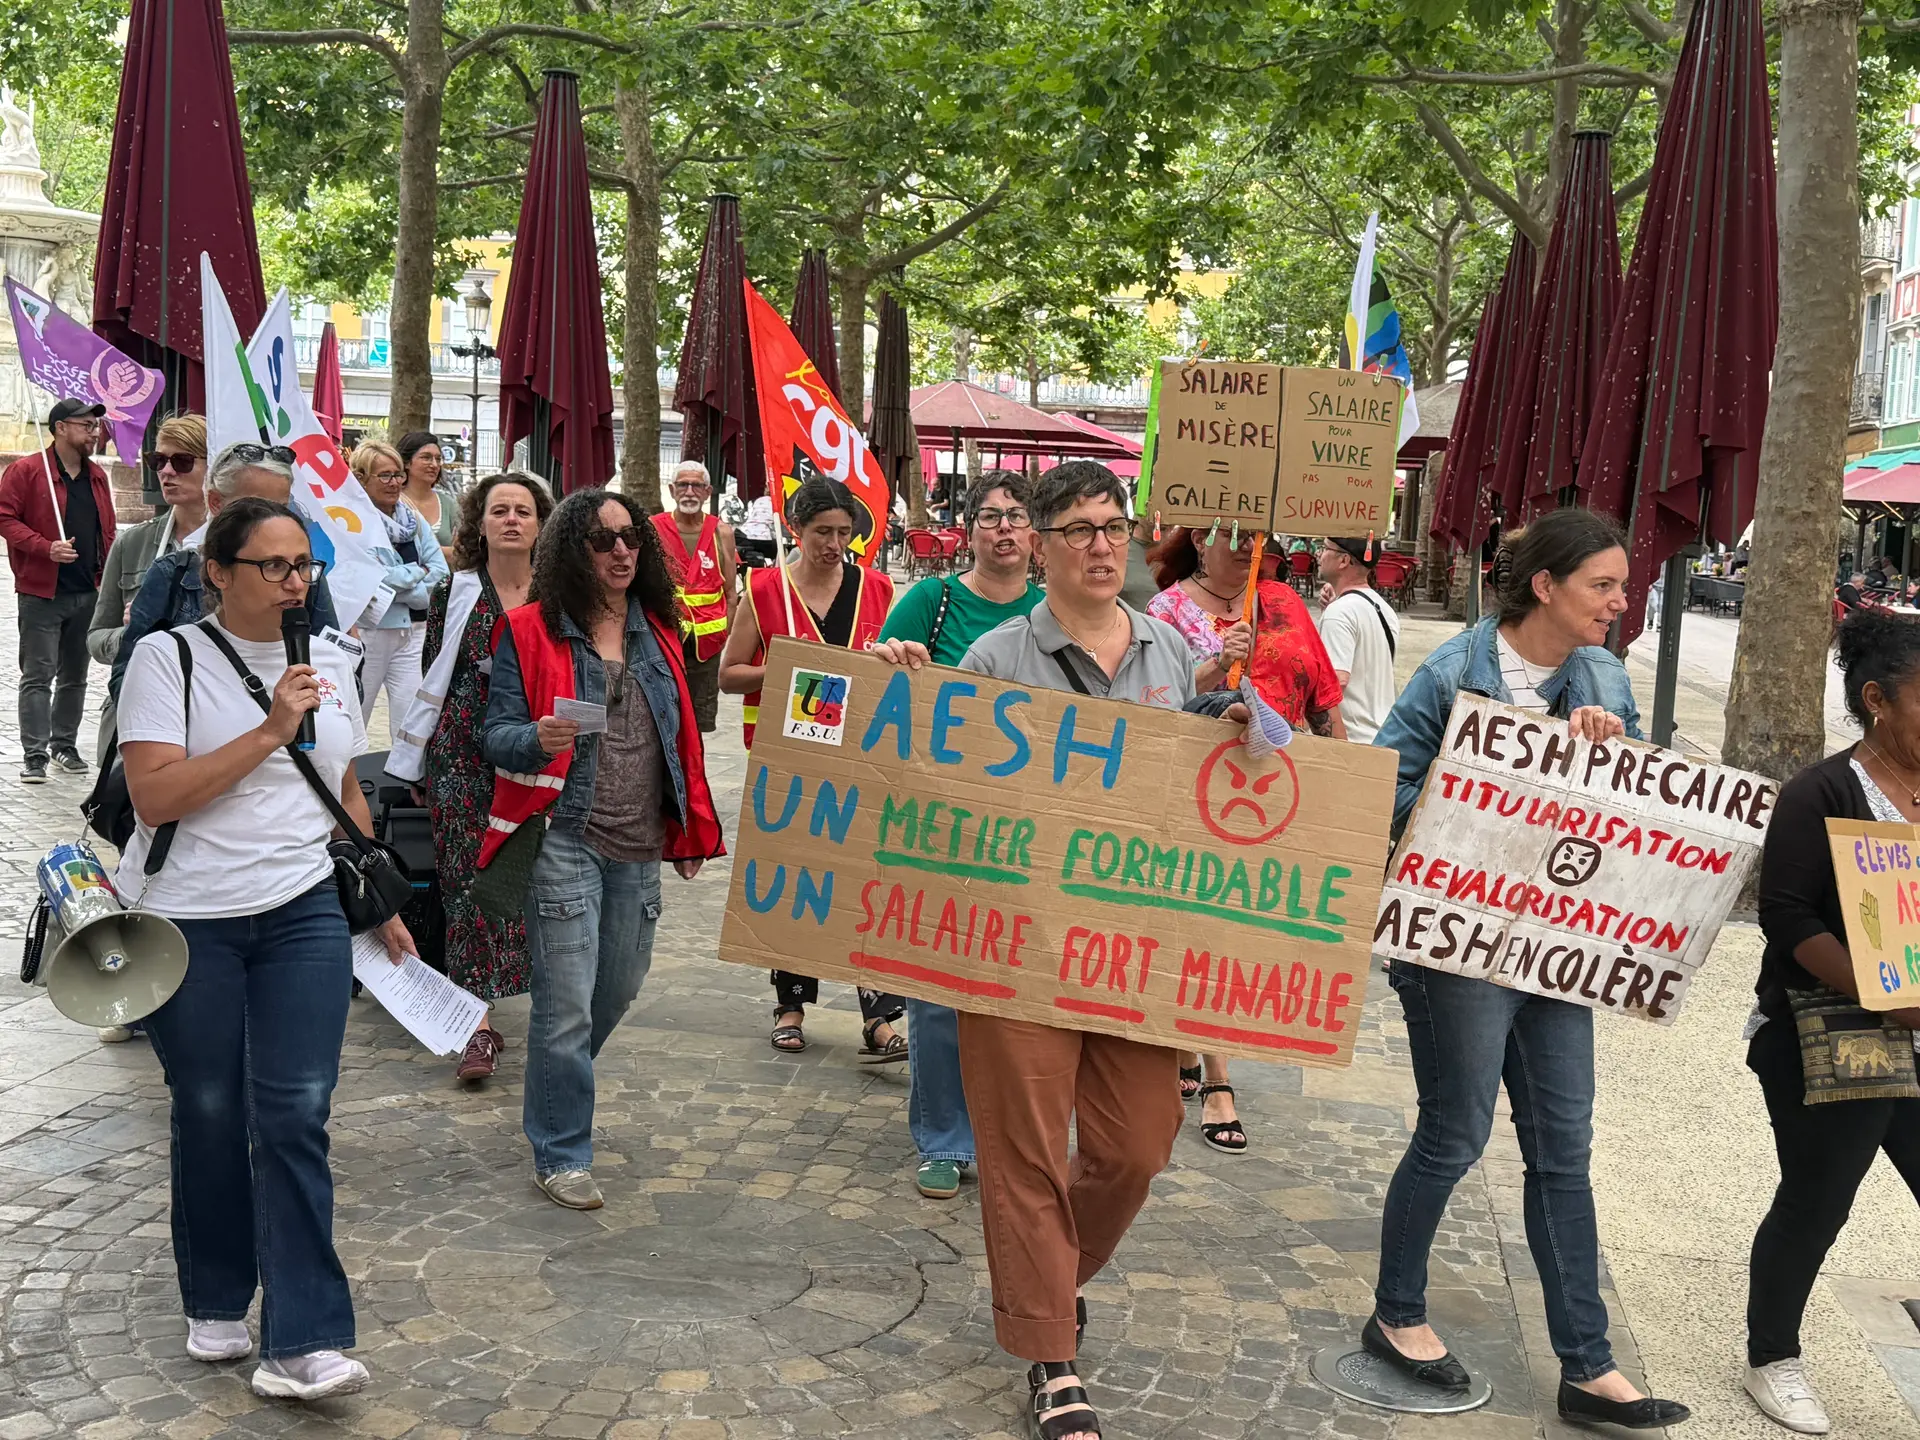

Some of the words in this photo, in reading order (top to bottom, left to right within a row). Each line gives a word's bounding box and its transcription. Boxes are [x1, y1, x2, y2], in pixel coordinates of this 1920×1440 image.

[1179, 368, 1268, 396] SALAIRE
[1338, 376, 1356, 388] UN
[1215, 401, 1228, 411] DE
[1307, 391, 1393, 423] SALAIRE
[1177, 417, 1276, 450] MISÈRE
[1328, 425, 1352, 437] POUR
[1312, 441, 1373, 467] VIVRE
[1302, 473, 1320, 484] PAS
[1347, 476, 1373, 489] POUR
[1165, 484, 1268, 514] GALÈRE
[1283, 496, 1380, 521] SURVIVRE
[791, 722, 837, 741] F.S.U.
[861, 671, 1126, 789] AESH
[1453, 709, 1576, 778] AESH
[1583, 744, 1777, 830] PRÉCAIRE
[1441, 772, 1733, 875] TITULARISATION
[752, 765, 859, 845] UN
[877, 793, 1037, 868] METIER
[1061, 828, 1353, 925] FORMIDABLE
[1396, 853, 1690, 953] REVALORISATION
[744, 858, 834, 926] UN
[855, 879, 1033, 967] SALAIRE
[1059, 926, 1160, 994] FORT
[1176, 948, 1354, 1033] MINABLE
[1374, 898, 1504, 970] AESH
[1504, 936, 1534, 978] EN
[1537, 943, 1684, 1018] COLÈRE
[1879, 961, 1901, 993] EN
